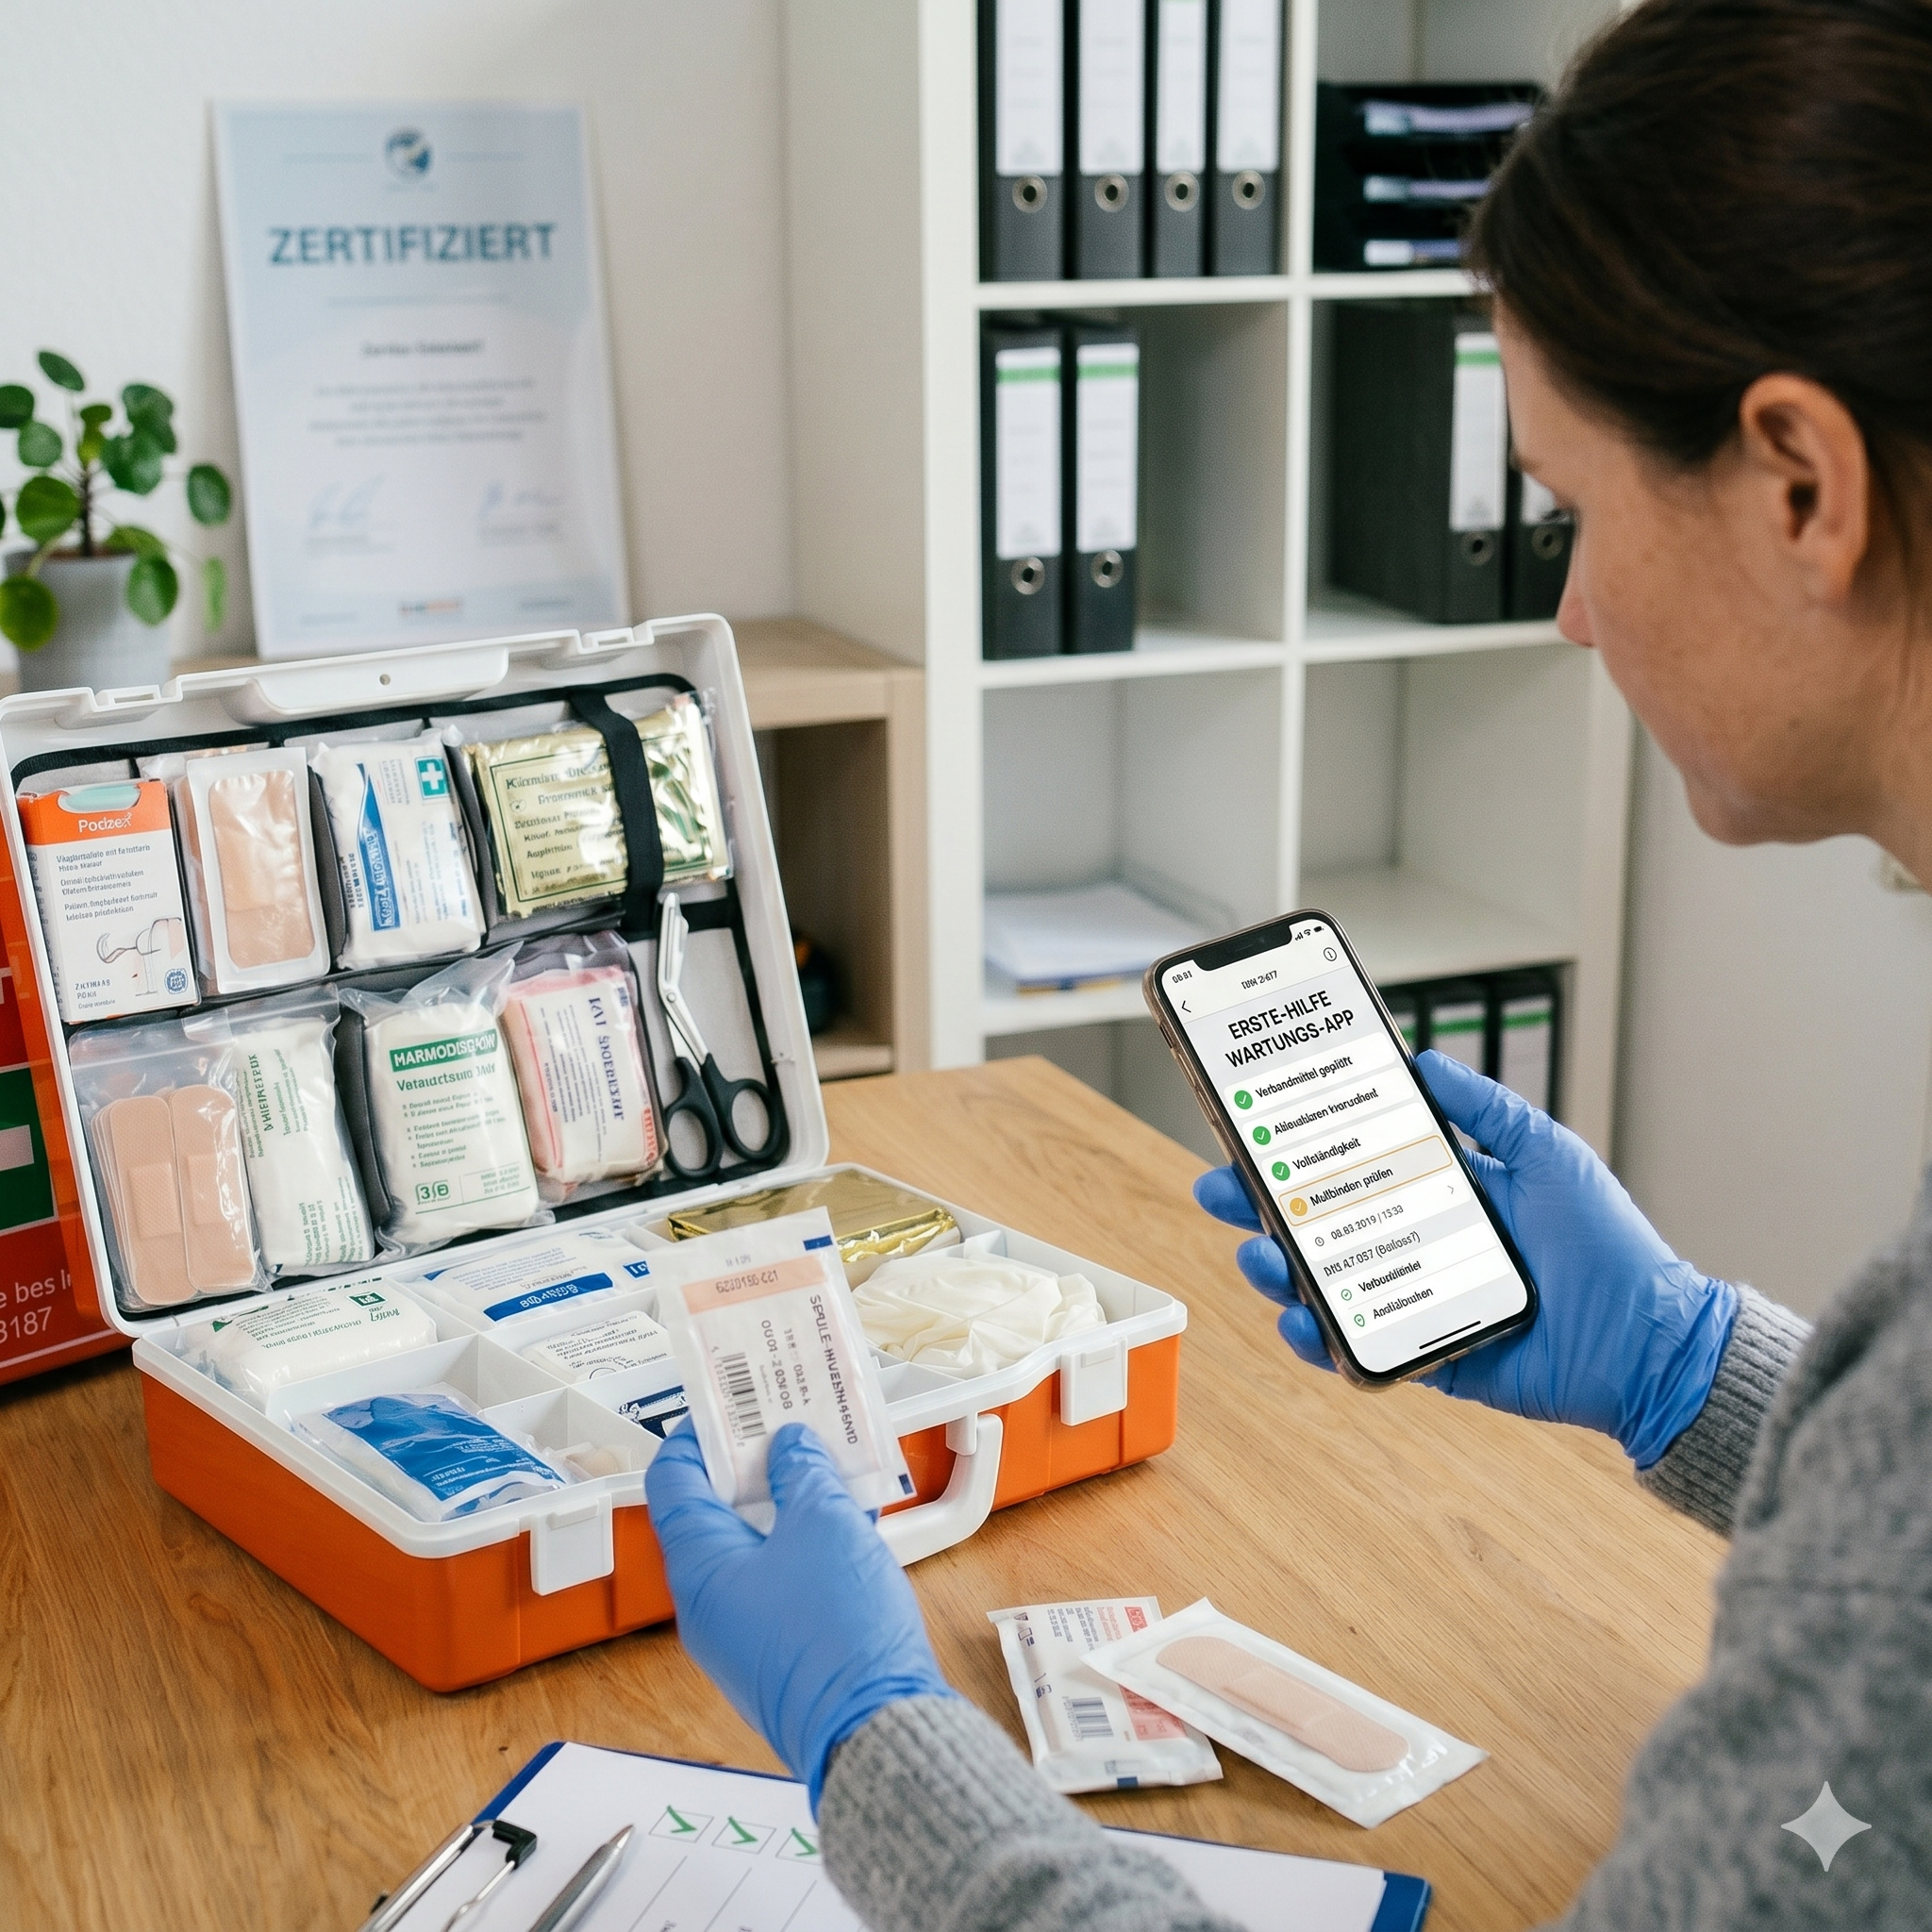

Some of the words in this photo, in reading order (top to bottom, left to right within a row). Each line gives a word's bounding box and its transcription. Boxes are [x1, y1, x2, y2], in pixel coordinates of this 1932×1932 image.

[269, 221, 557, 265] ZERTIFIZIERT
[1225, 1009, 1353, 1067] WARTUNGS-APP
[1228, 991, 1331, 1040] ERSTE-HILFE
[15, 1278, 55, 1303] bes
